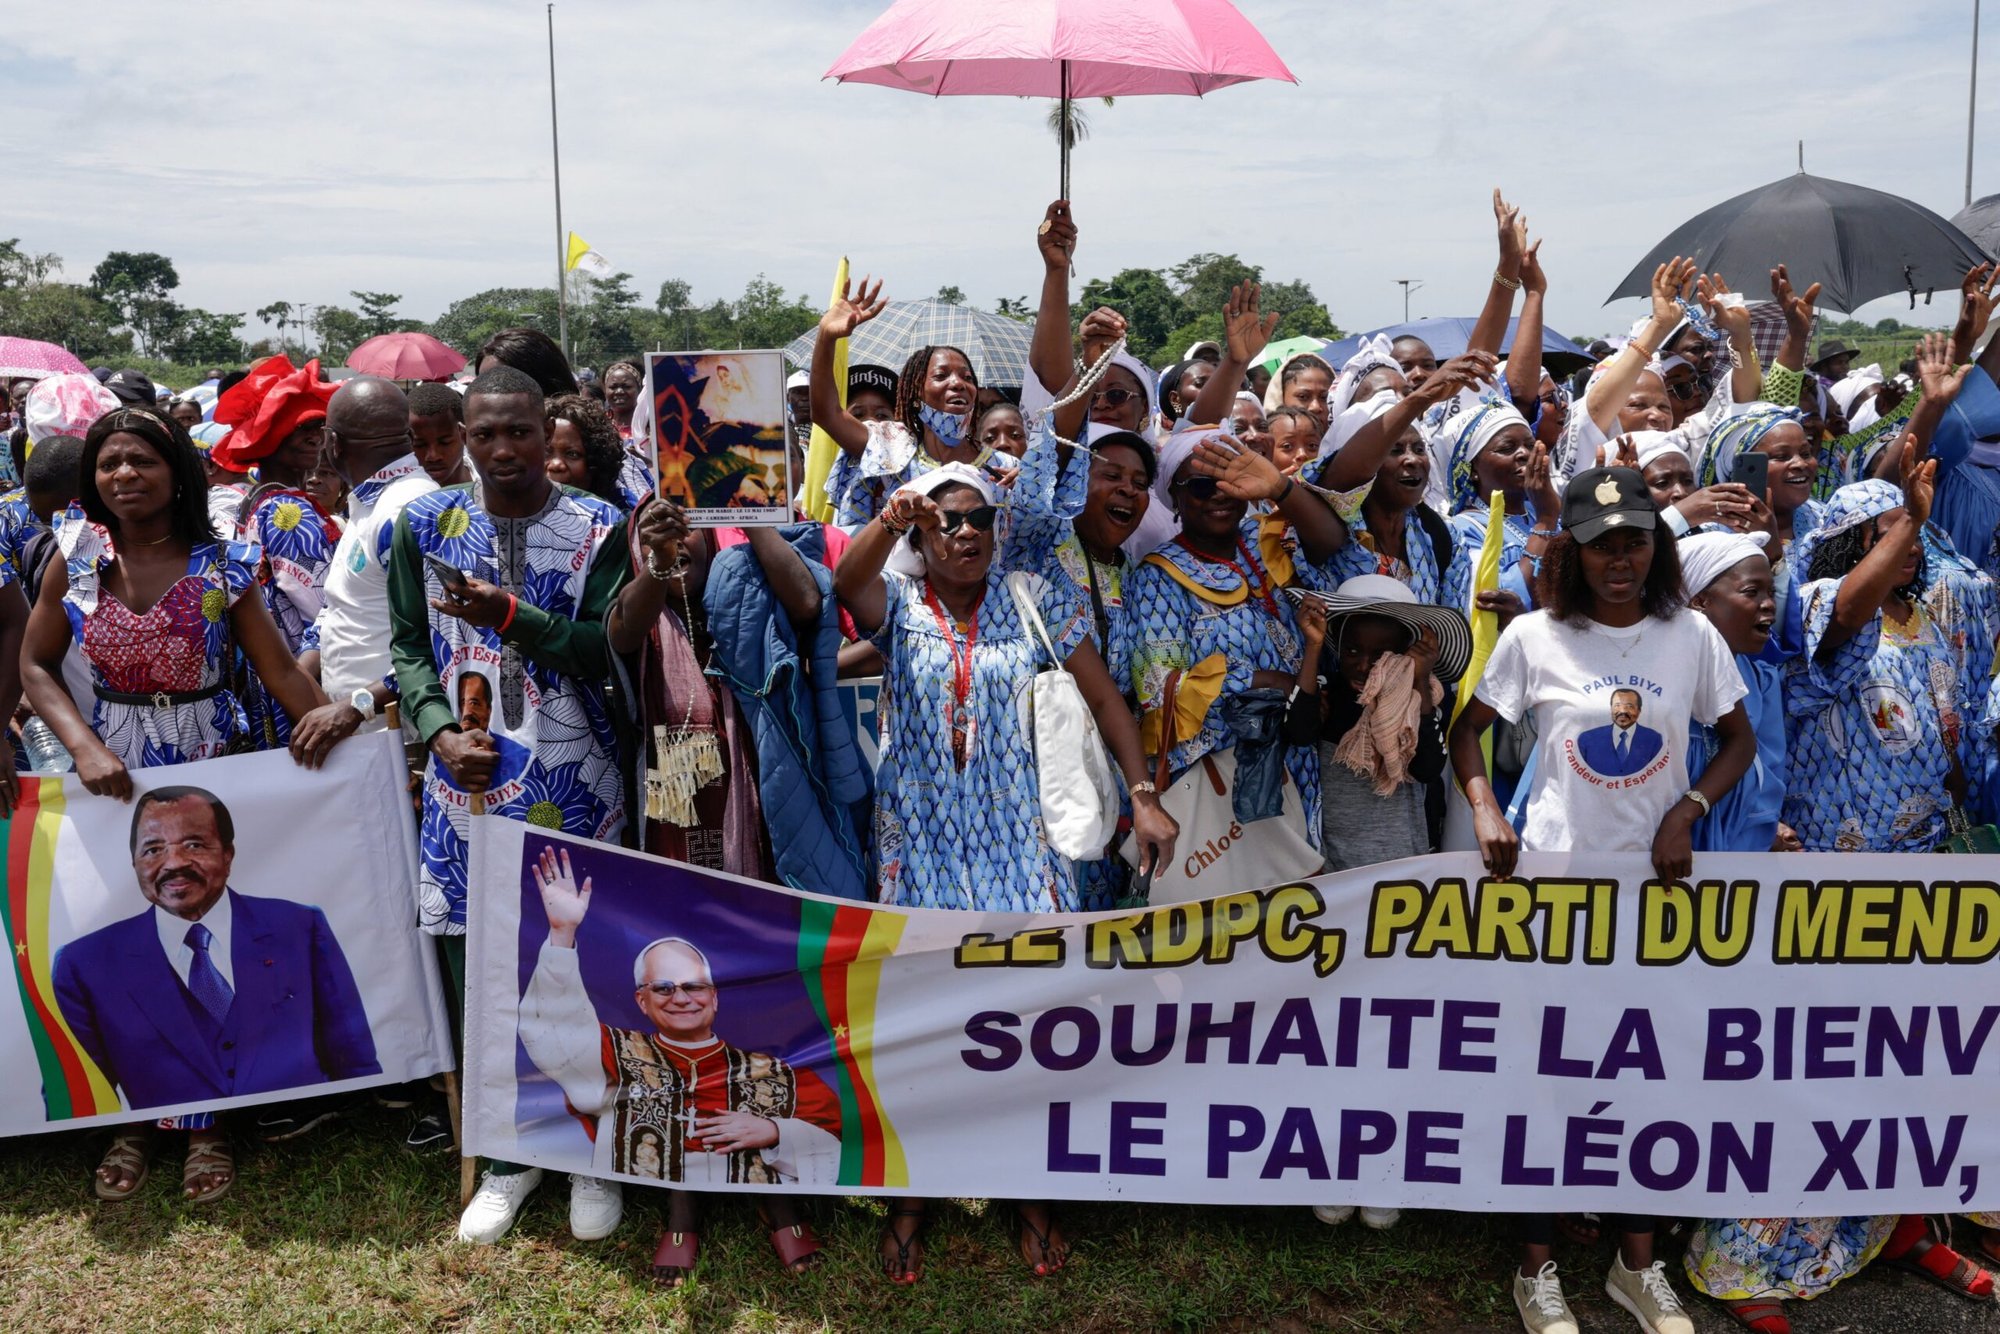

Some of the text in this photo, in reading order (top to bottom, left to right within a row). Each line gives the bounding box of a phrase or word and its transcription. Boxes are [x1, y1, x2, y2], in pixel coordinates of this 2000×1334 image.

[1582, 674, 1663, 697] PAUL BIYA
[485, 781, 523, 806] BIYA
[1564, 739, 1671, 790] Grandeur et Espéran
[1184, 820, 1244, 878] Chloé
[1085, 881, 1347, 978] RDPC,
[1364, 877, 1619, 964] PARTI
[1636, 879, 1760, 966] DU
[1772, 879, 2000, 965] MEND
[960, 997, 2000, 1081] SOUHAITE LA BIENV
[1047, 1100, 1979, 1205] LE PAPE LÉON XIV,
